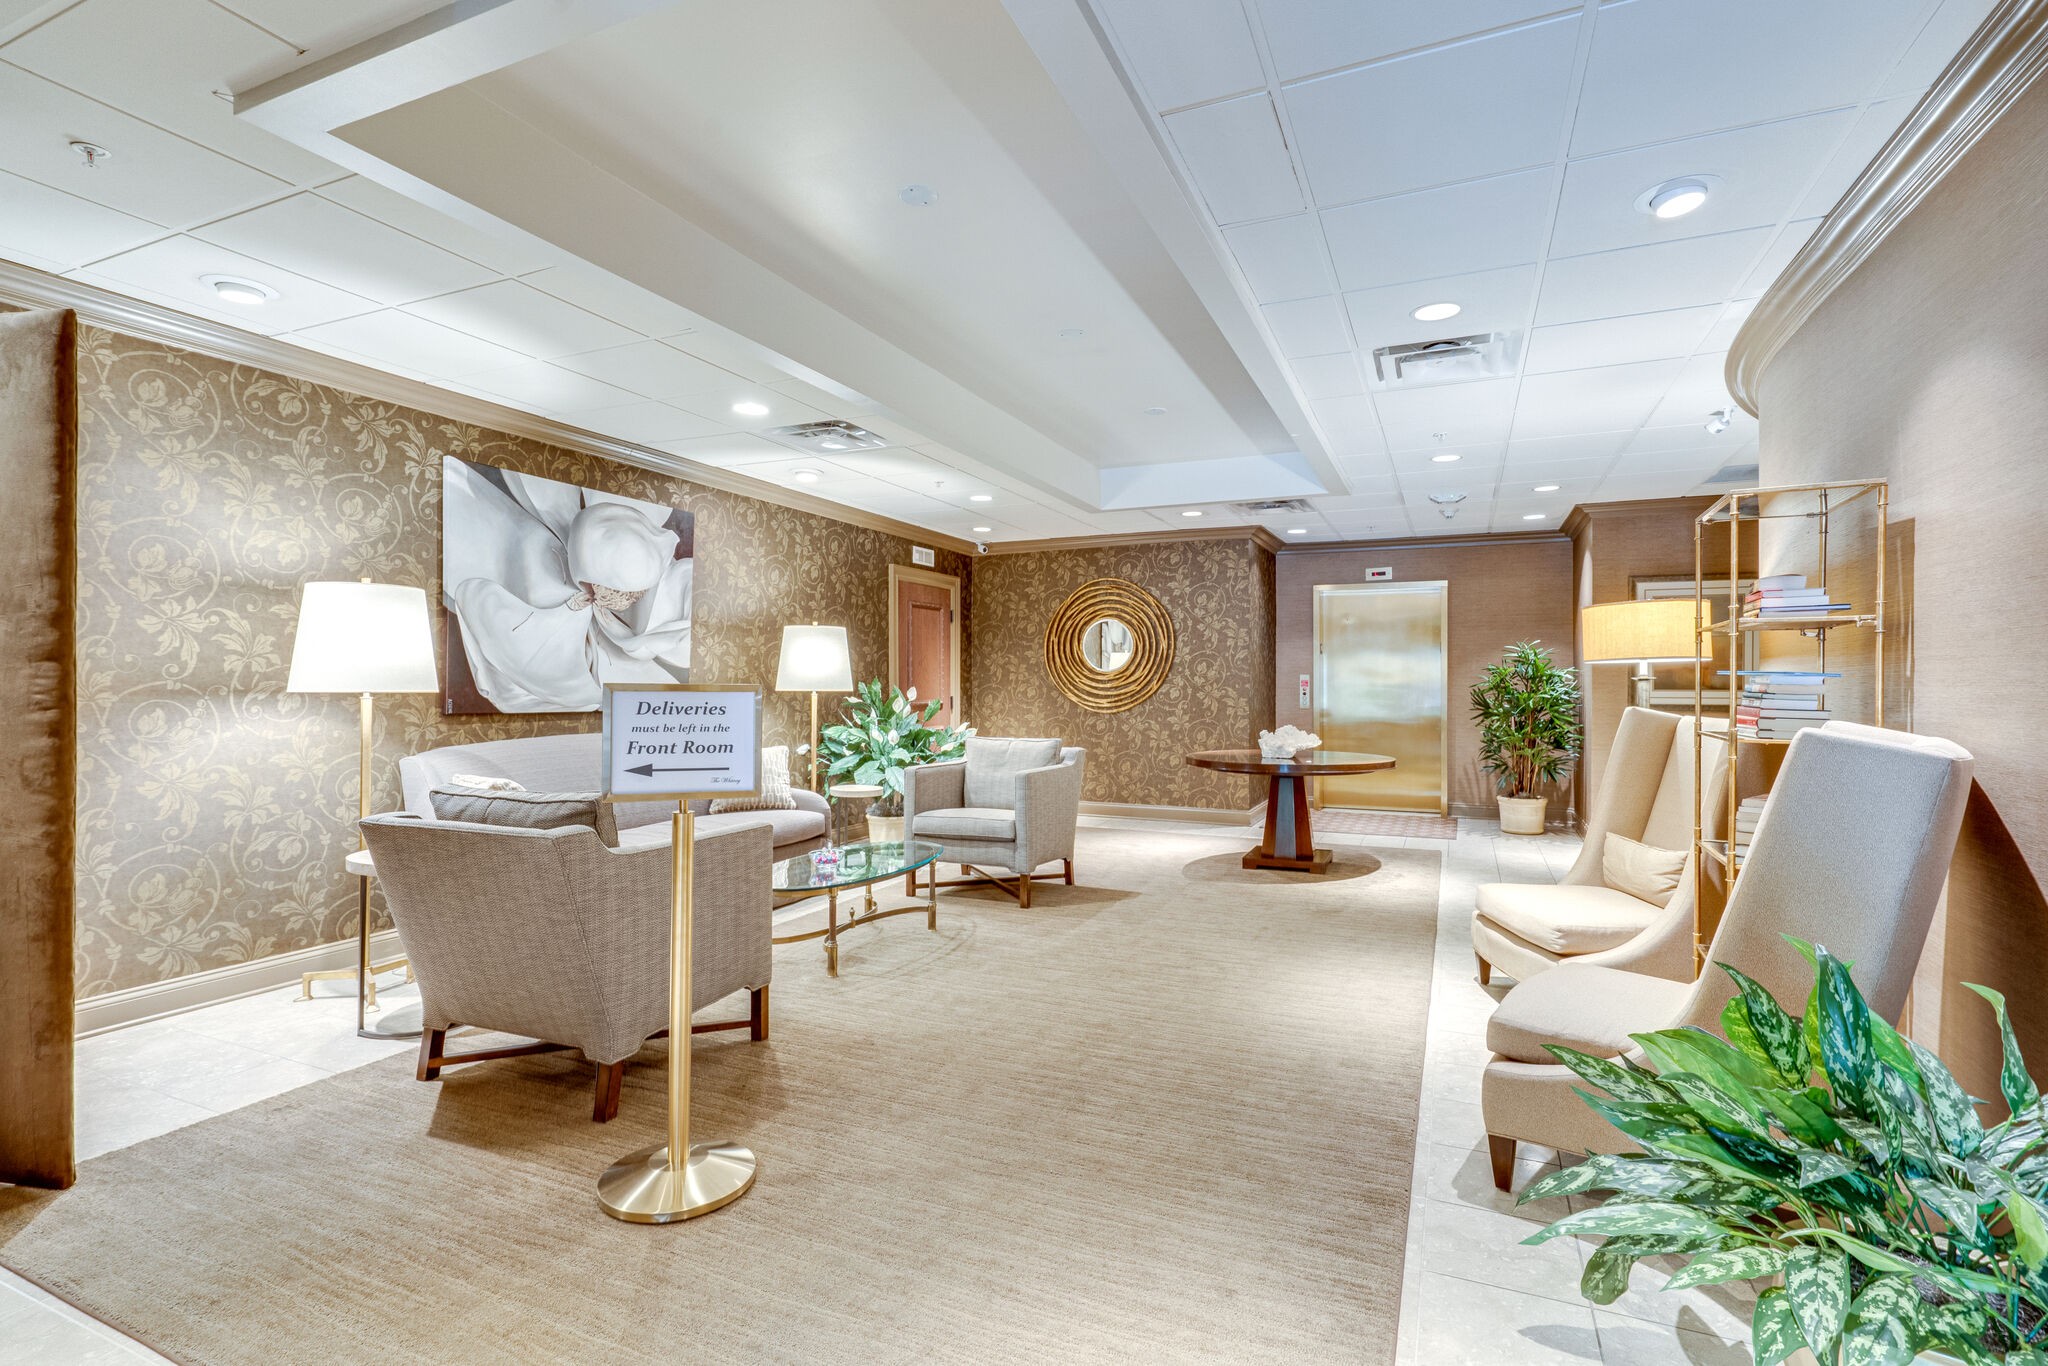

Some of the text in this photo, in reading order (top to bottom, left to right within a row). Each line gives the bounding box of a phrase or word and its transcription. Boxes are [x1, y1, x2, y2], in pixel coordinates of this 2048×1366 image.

[636, 701, 726, 715] Deliveries
[631, 723, 730, 735] must be left in the
[627, 740, 734, 755] Front Room
